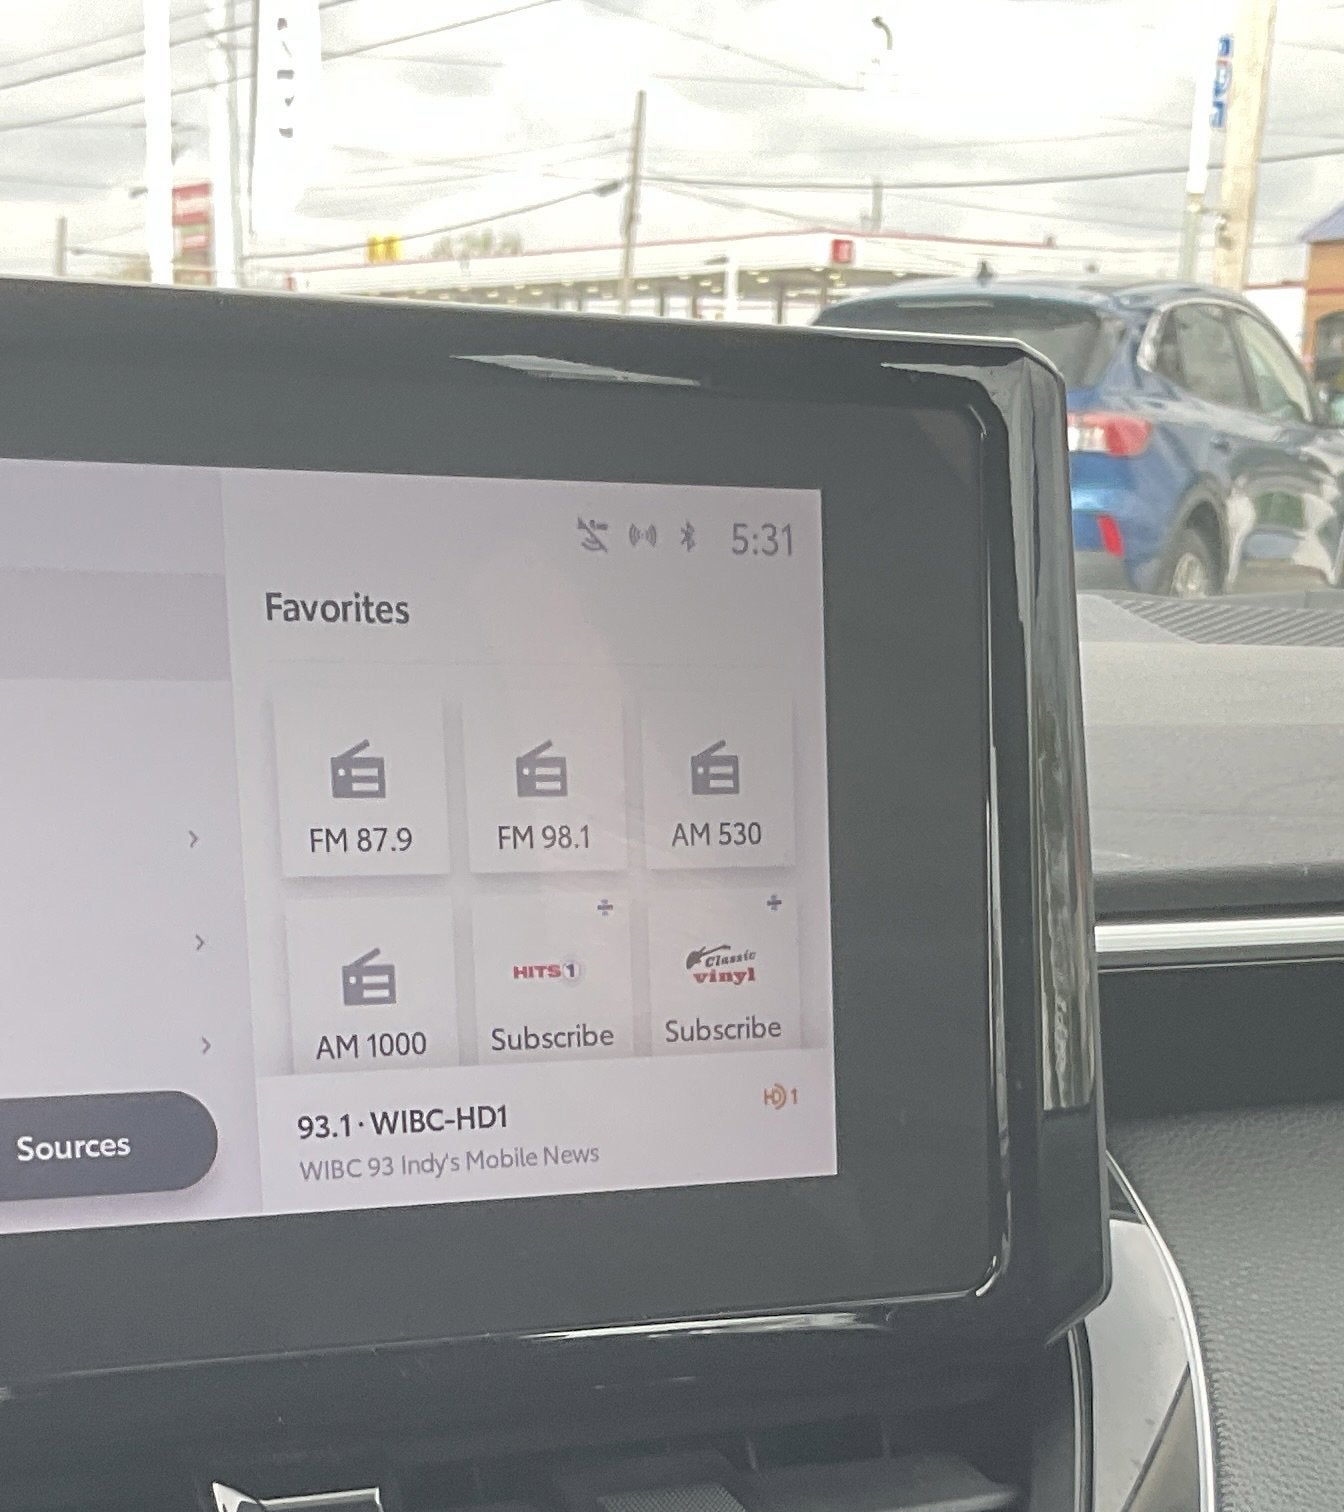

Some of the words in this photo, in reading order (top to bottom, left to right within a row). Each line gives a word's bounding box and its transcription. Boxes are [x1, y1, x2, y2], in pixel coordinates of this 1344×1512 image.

[731, 522, 792, 557] 5:31
[264, 591, 410, 625] Favorites
[309, 828, 348, 853] FM
[356, 827, 413, 854] 87.9
[498, 825, 534, 849] FM
[541, 823, 590, 849] 98.1
[672, 823, 711, 847] AM
[718, 821, 761, 846] 530
[513, 964, 561, 979] HITS
[705, 950, 756, 968] Classic
[692, 967, 756, 986] vinyl
[491, 1023, 614, 1051] Subscribe
[665, 1015, 782, 1043] Subscribe
[316, 1034, 359, 1060] AM
[367, 1031, 427, 1057] 1000
[370, 1104, 508, 1136] WIBC-HD1
[16, 1133, 131, 1162] Sources
[300, 1158, 362, 1181] WIBC
[368, 1156, 394, 1177] 93
[402, 1151, 460, 1178] Indy's
[466, 1146, 538, 1171] Mobile
[544, 1144, 600, 1166] News
